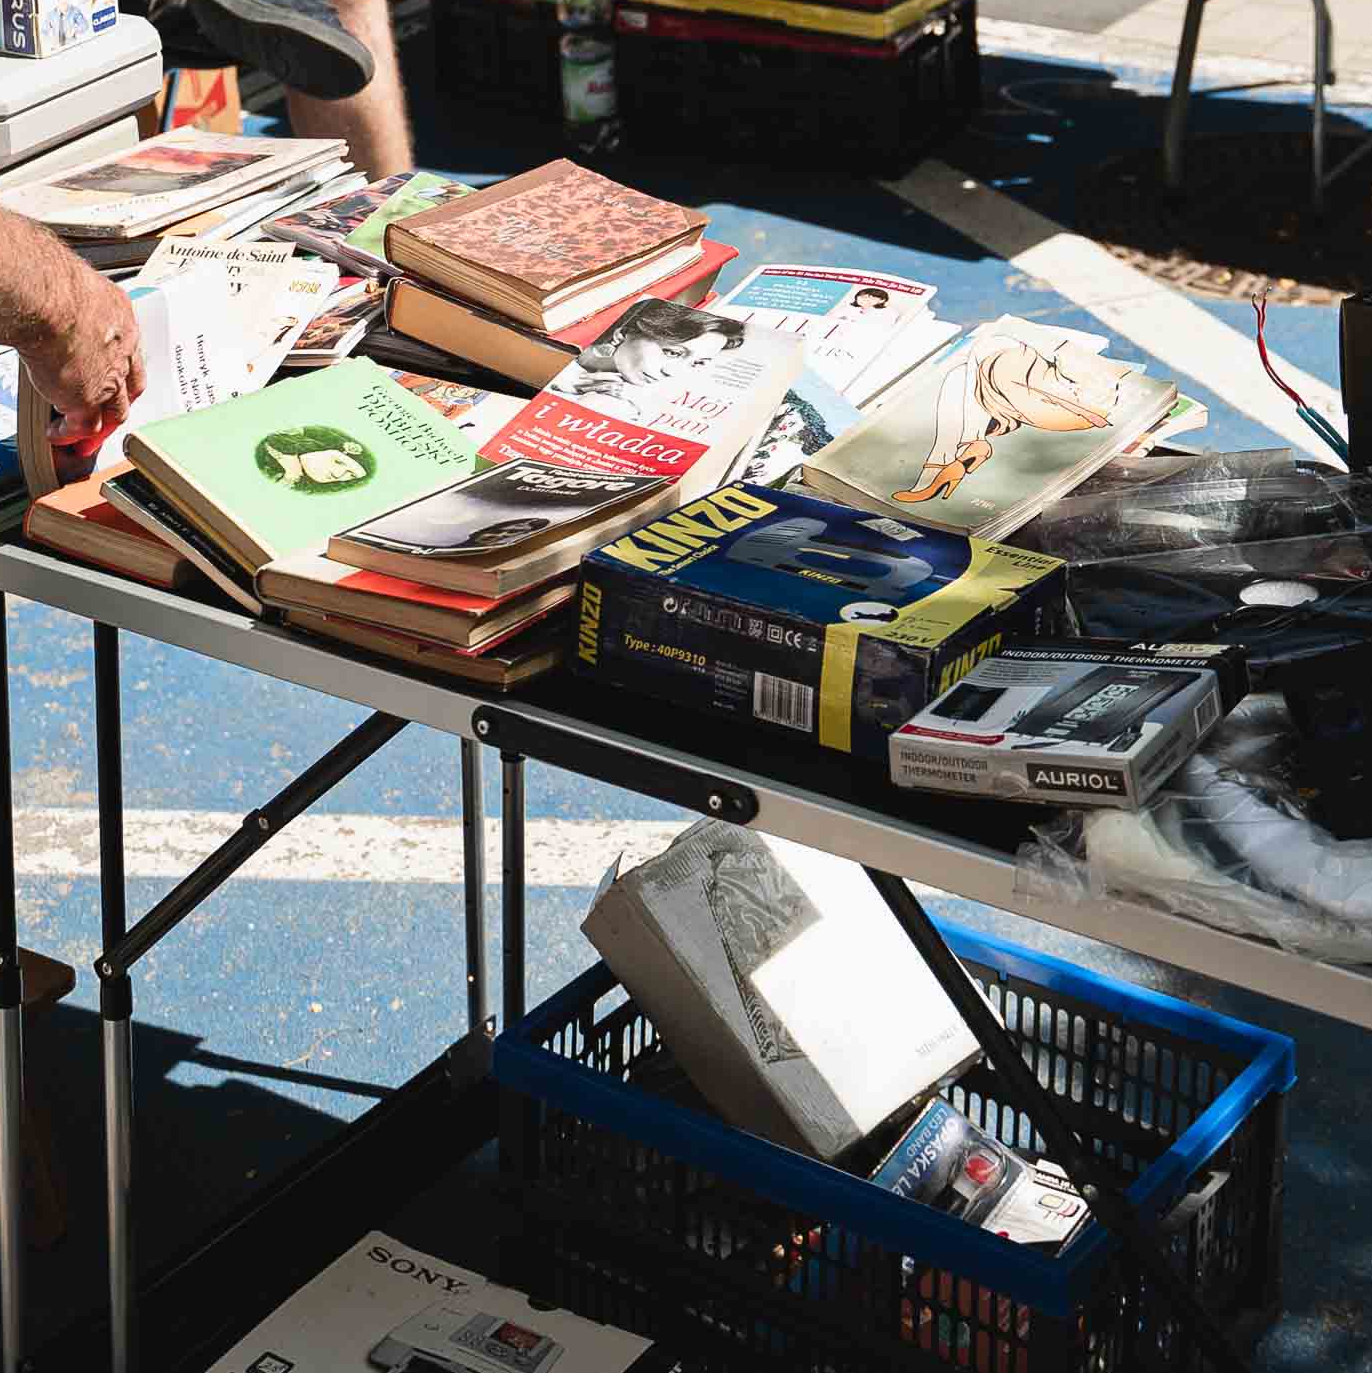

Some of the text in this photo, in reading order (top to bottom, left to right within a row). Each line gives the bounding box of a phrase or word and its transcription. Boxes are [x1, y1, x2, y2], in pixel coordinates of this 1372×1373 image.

[163, 243, 289, 264] Antoine de Saint
[205, 383, 217, 405] Jas
[363, 392, 451, 466] DIABELSKI
[534, 400, 559, 420] i
[557, 411, 686, 465] władca
[647, 411, 710, 436] pan
[505, 466, 636, 492] Tagore
[600, 486, 779, 572] KINZO
[984, 545, 1058, 567] Essential
[1011, 559, 1048, 572] Line
[798, 568, 844, 586] KINZO
[578, 582, 603, 666] KINZO
[656, 643, 707, 667] 40P9310
[1000, 649, 1209, 667] INDOOR/OUTDOOR THERMOMETER
[1034, 769, 1120, 791] AURIOL
[366, 1245, 469, 1296] SONY
